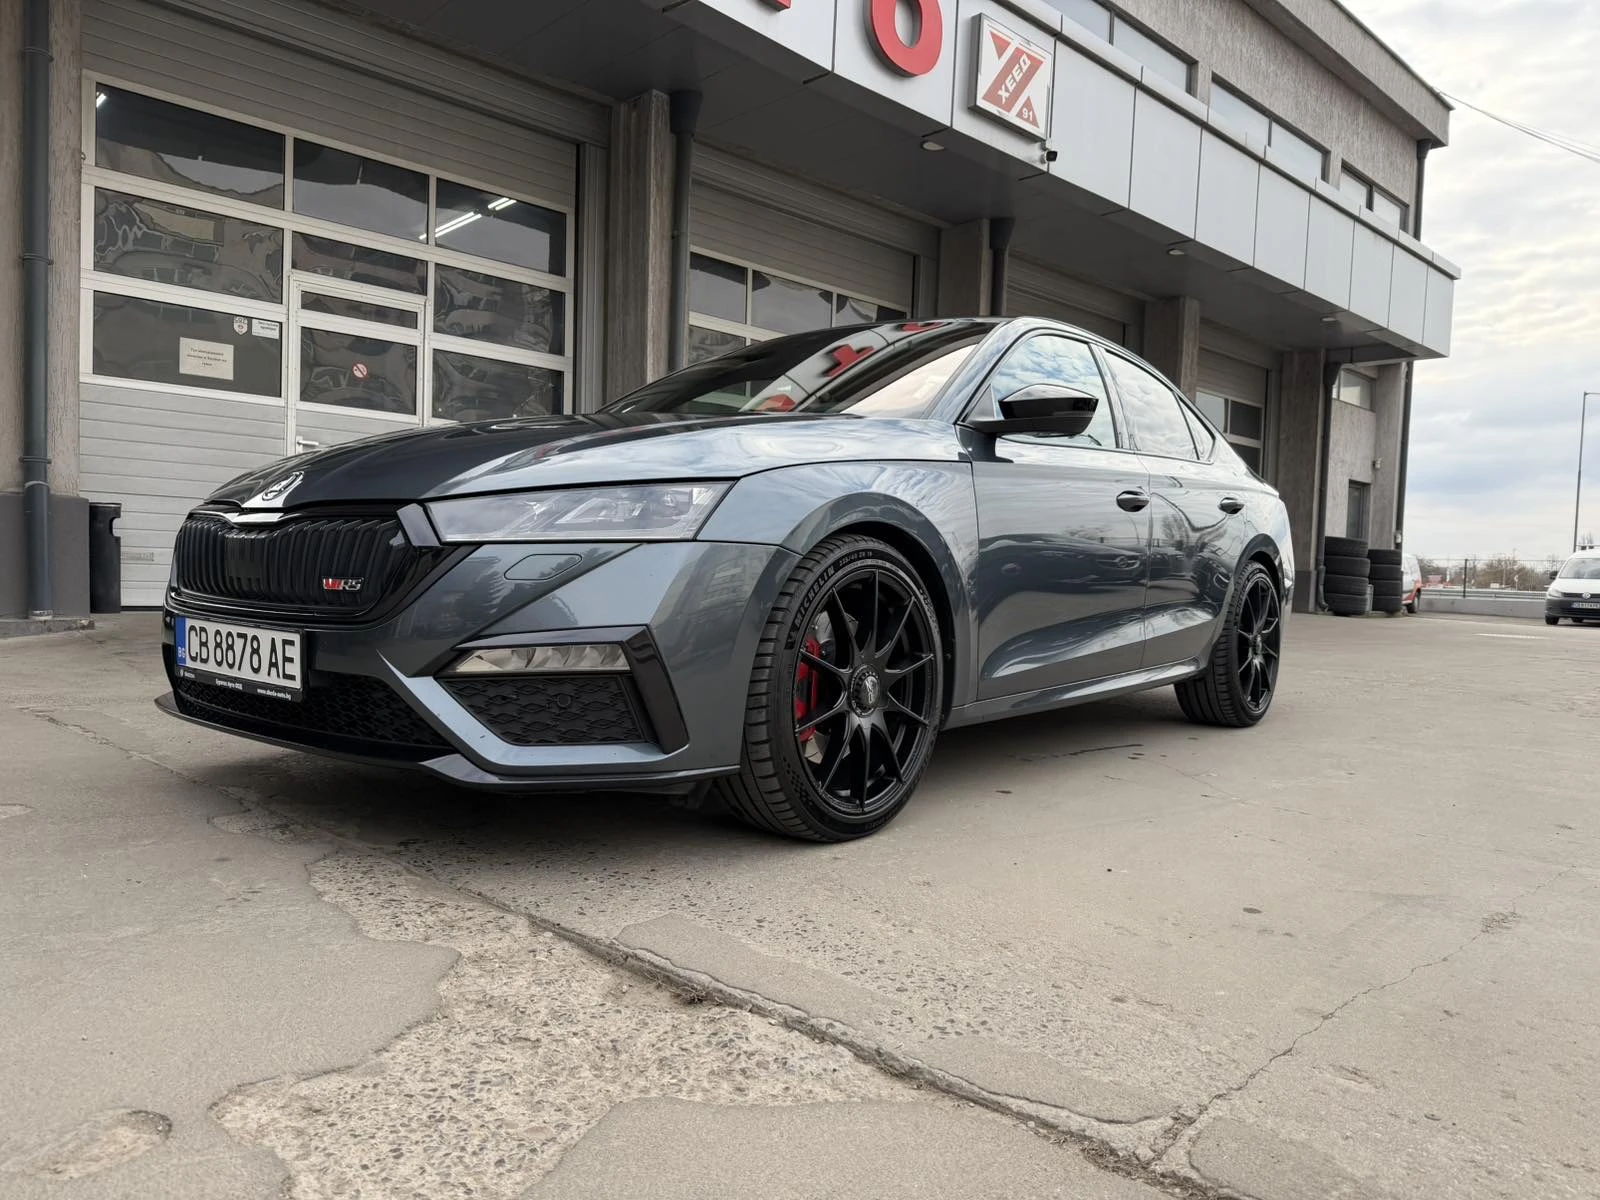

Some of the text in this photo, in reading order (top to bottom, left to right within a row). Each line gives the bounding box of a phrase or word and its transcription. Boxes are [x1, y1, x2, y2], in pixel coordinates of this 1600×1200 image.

[1022, 107, 1033, 121] 91
[794, 565, 836, 628] MICHELIN
[188, 624, 297, 682] CB 8878 AE
